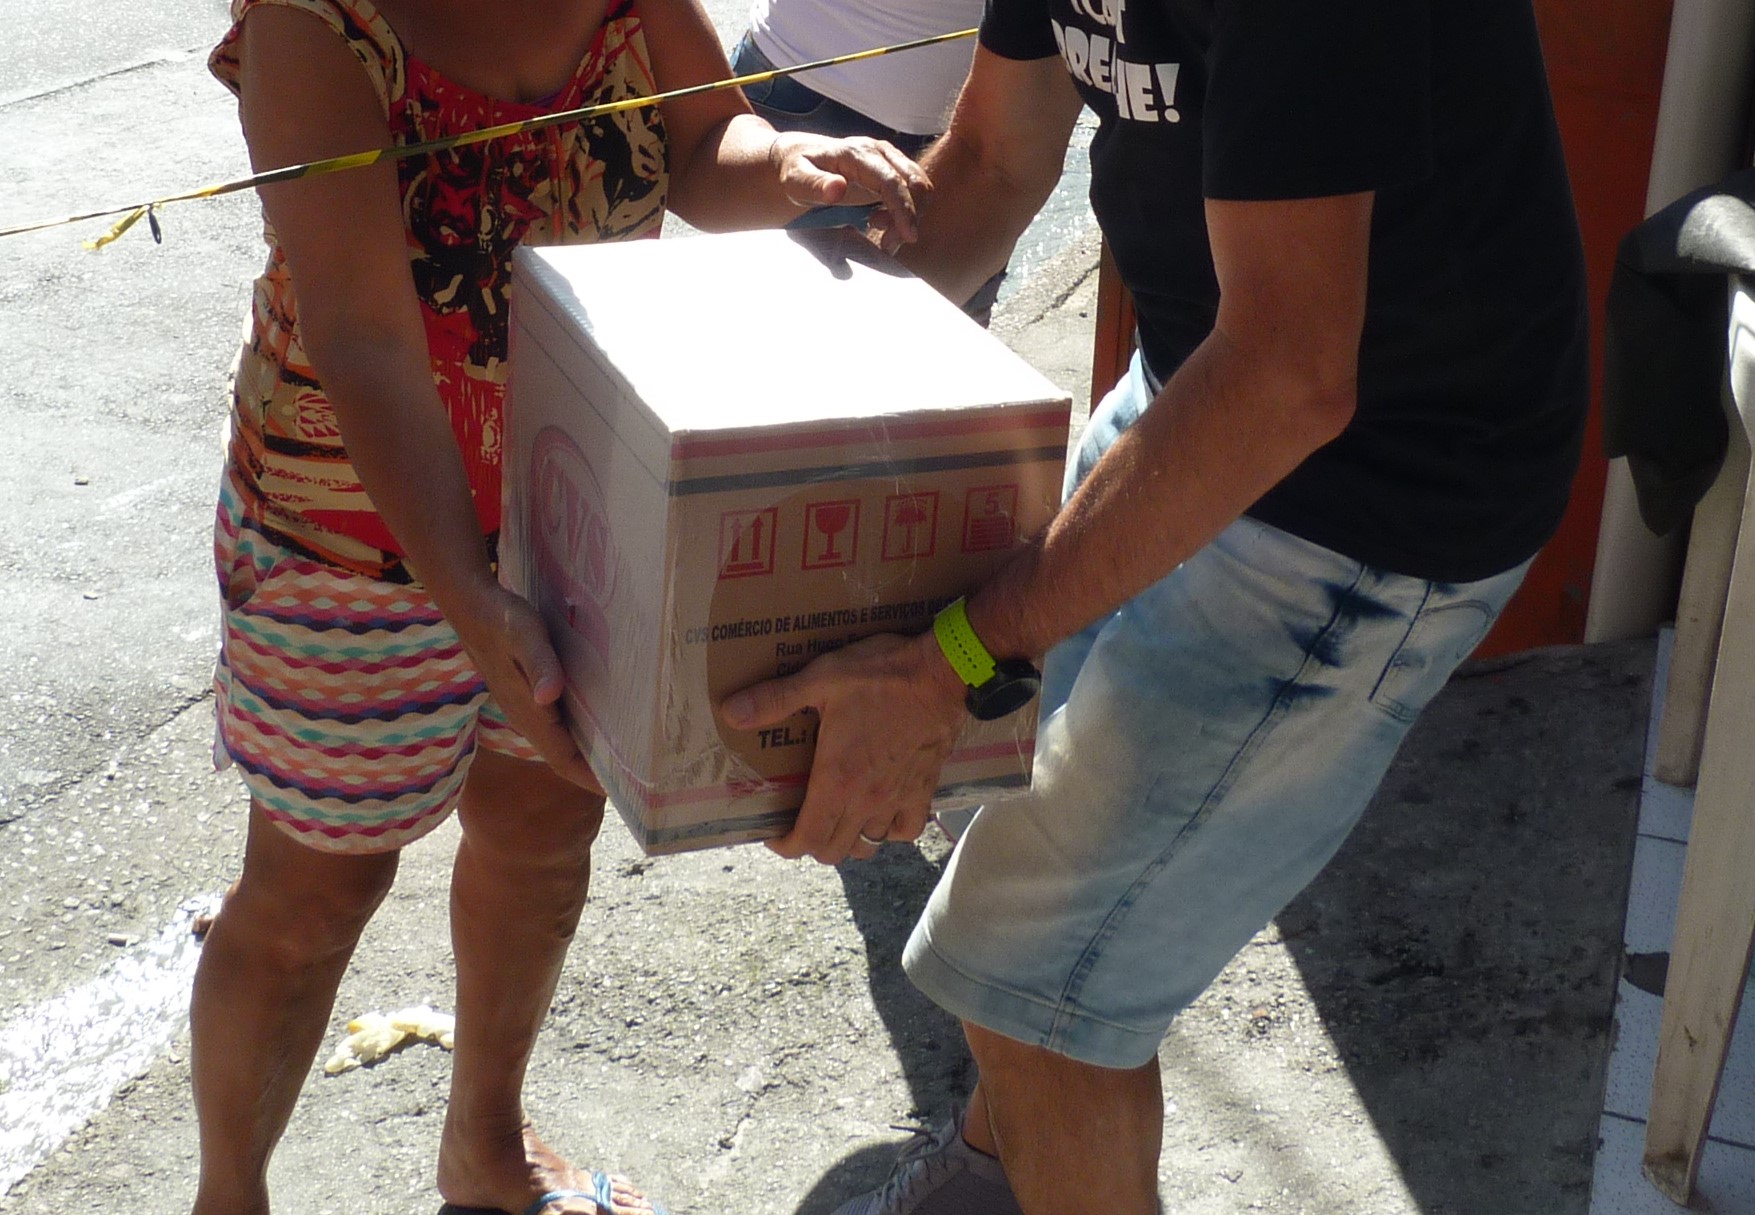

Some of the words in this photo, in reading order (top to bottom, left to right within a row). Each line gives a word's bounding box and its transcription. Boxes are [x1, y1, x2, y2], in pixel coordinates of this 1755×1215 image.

[541, 457, 607, 595] CVS
[685, 627, 709, 644] CVS
[711, 618, 772, 641] COMÉRCIO
[775, 616, 791, 633] DE
[793, 608, 858, 632] ALIMENTOS
[860, 607, 868, 624] E
[776, 642, 803, 657] Rua
